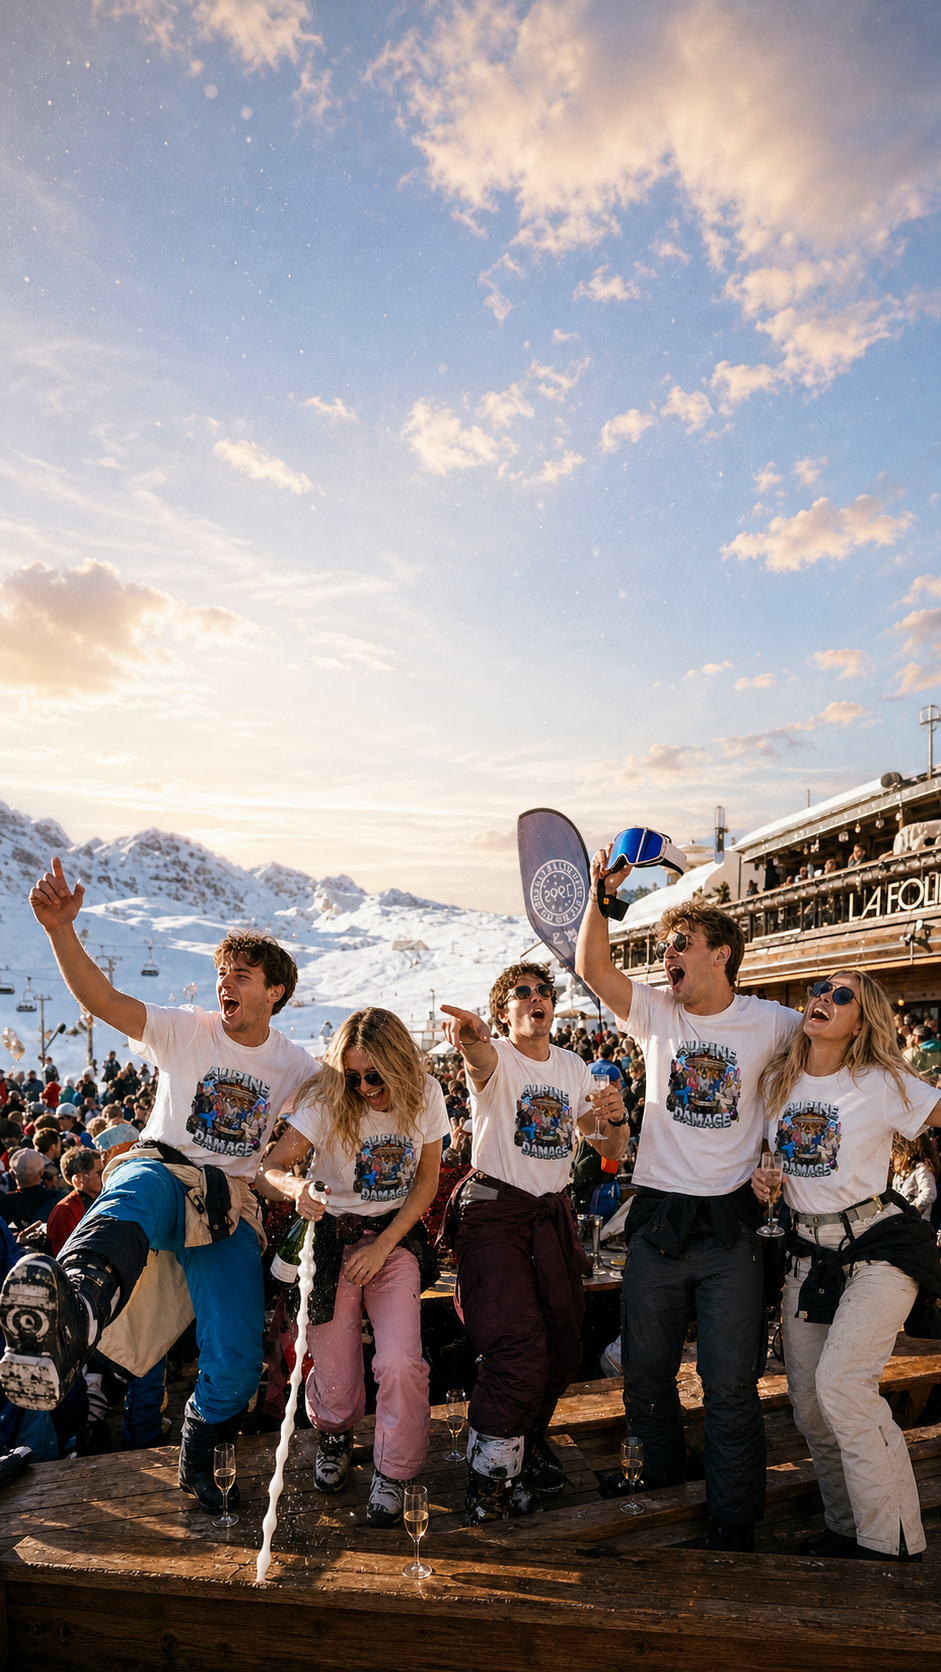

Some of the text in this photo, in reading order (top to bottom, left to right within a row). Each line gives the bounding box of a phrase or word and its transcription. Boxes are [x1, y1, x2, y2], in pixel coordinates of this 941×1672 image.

[849, 872, 941, 922] LA FOLI
[676, 1040, 737, 1064] ALPINE
[203, 1066, 270, 1098] ALPINE
[521, 1084, 569, 1104] ALPINE
[673, 1106, 732, 1128] DAMAGE
[782, 1101, 839, 1119] ALPINE
[193, 1129, 254, 1157] DAMAGE
[521, 1141, 569, 1159] DAMAGE
[361, 1187, 409, 1202] DAMAGE
